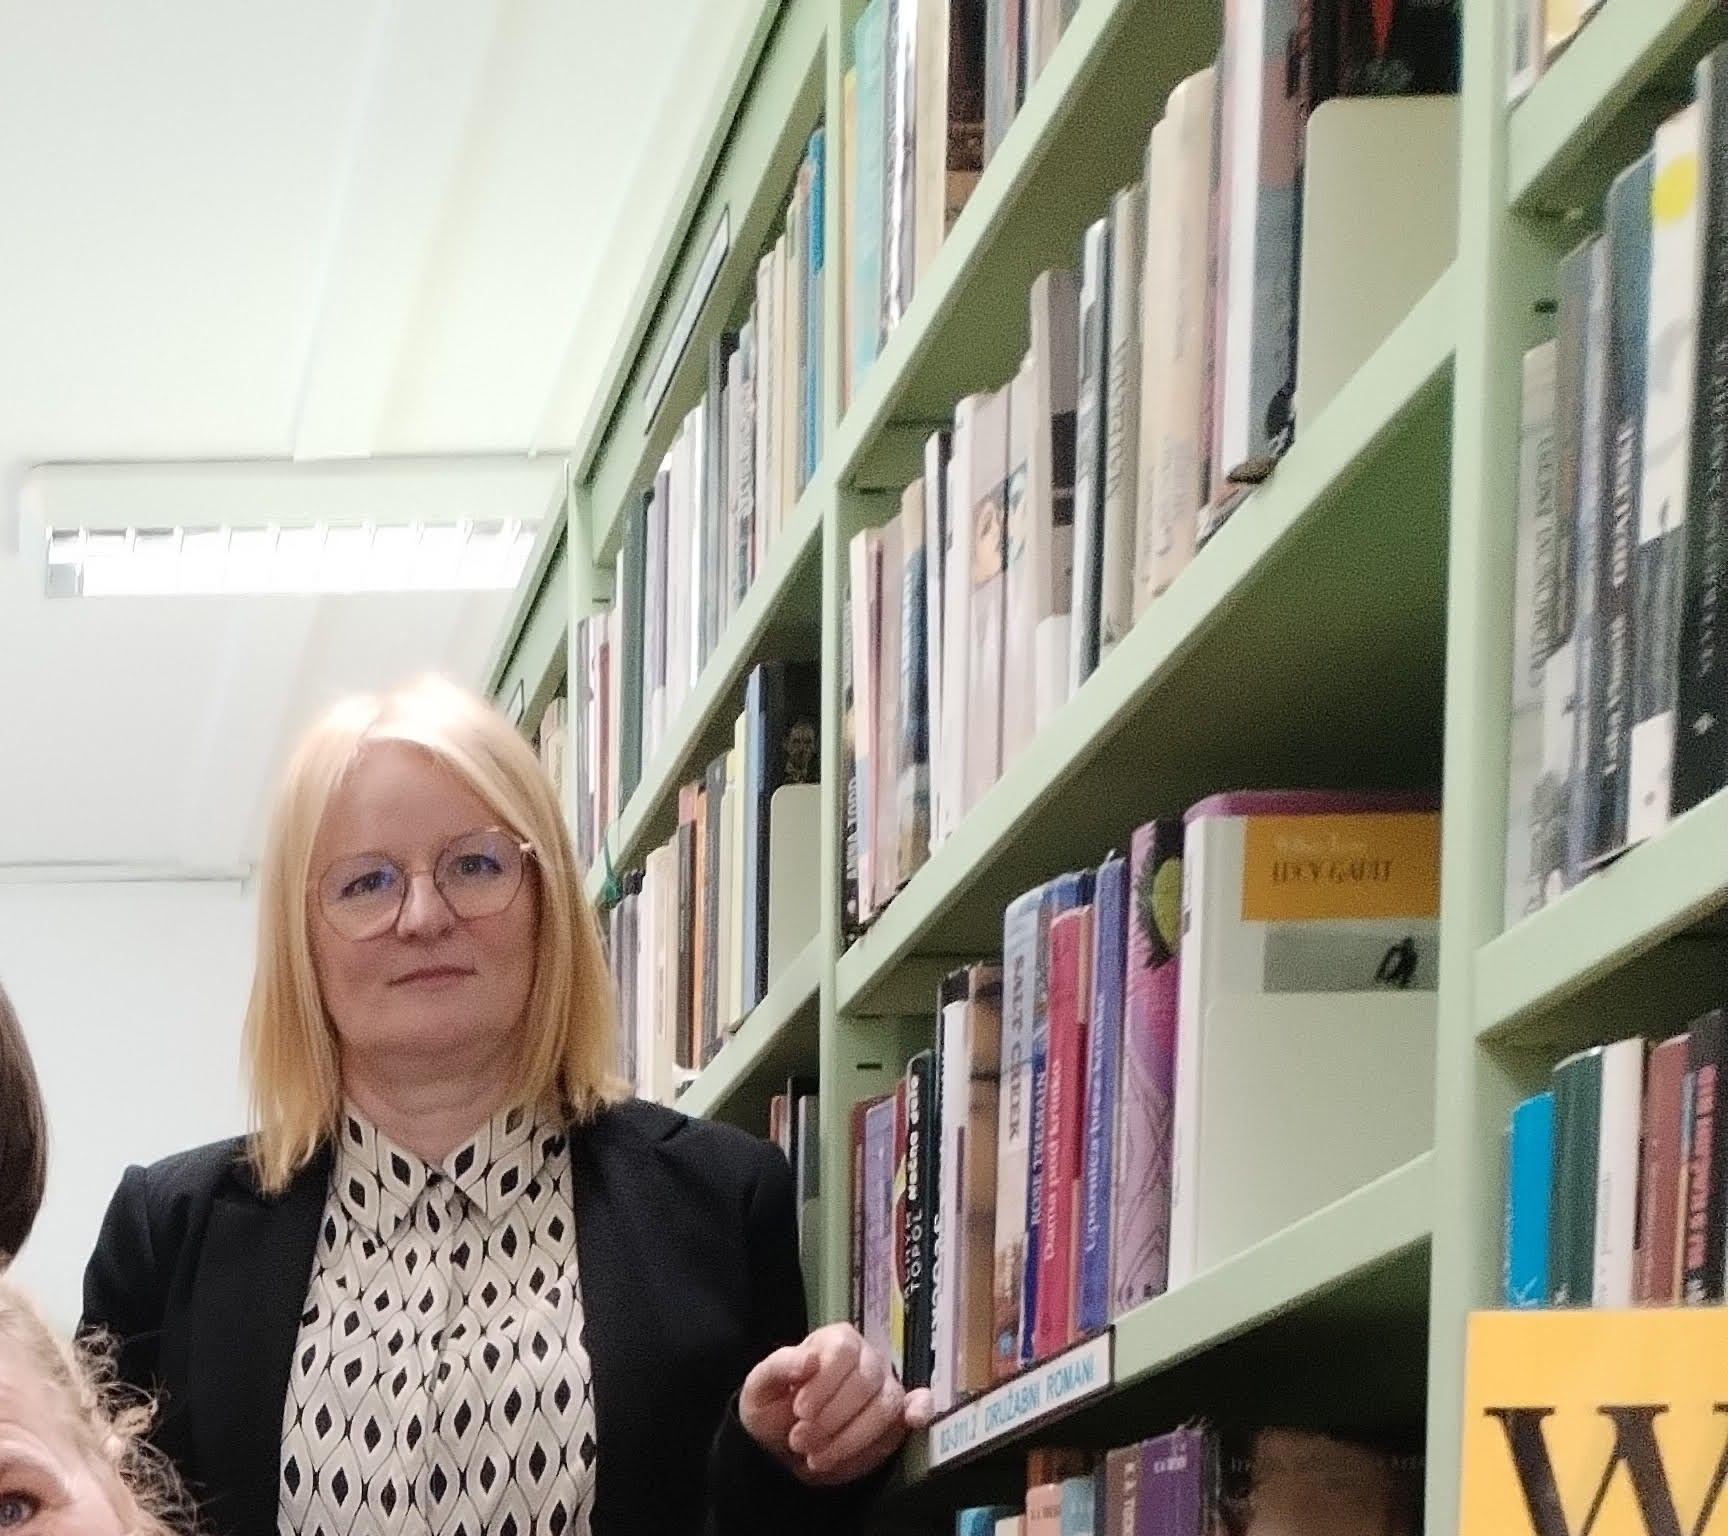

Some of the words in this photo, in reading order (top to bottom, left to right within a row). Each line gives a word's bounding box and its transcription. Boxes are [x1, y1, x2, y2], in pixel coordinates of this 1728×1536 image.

[1009, 955, 1024, 1032] SALT
[1008, 1041, 1024, 1141] CREEK
[1030, 1176, 1043, 1226] ROSE
[1046, 1140, 1061, 1187] pod
[909, 1209, 923, 1292] TOPOL
[1044, 1192, 1057, 1261] Dama
[985, 1382, 1041, 1432] DRUŽABNI
[1046, 1352, 1096, 1399] ROMANI
